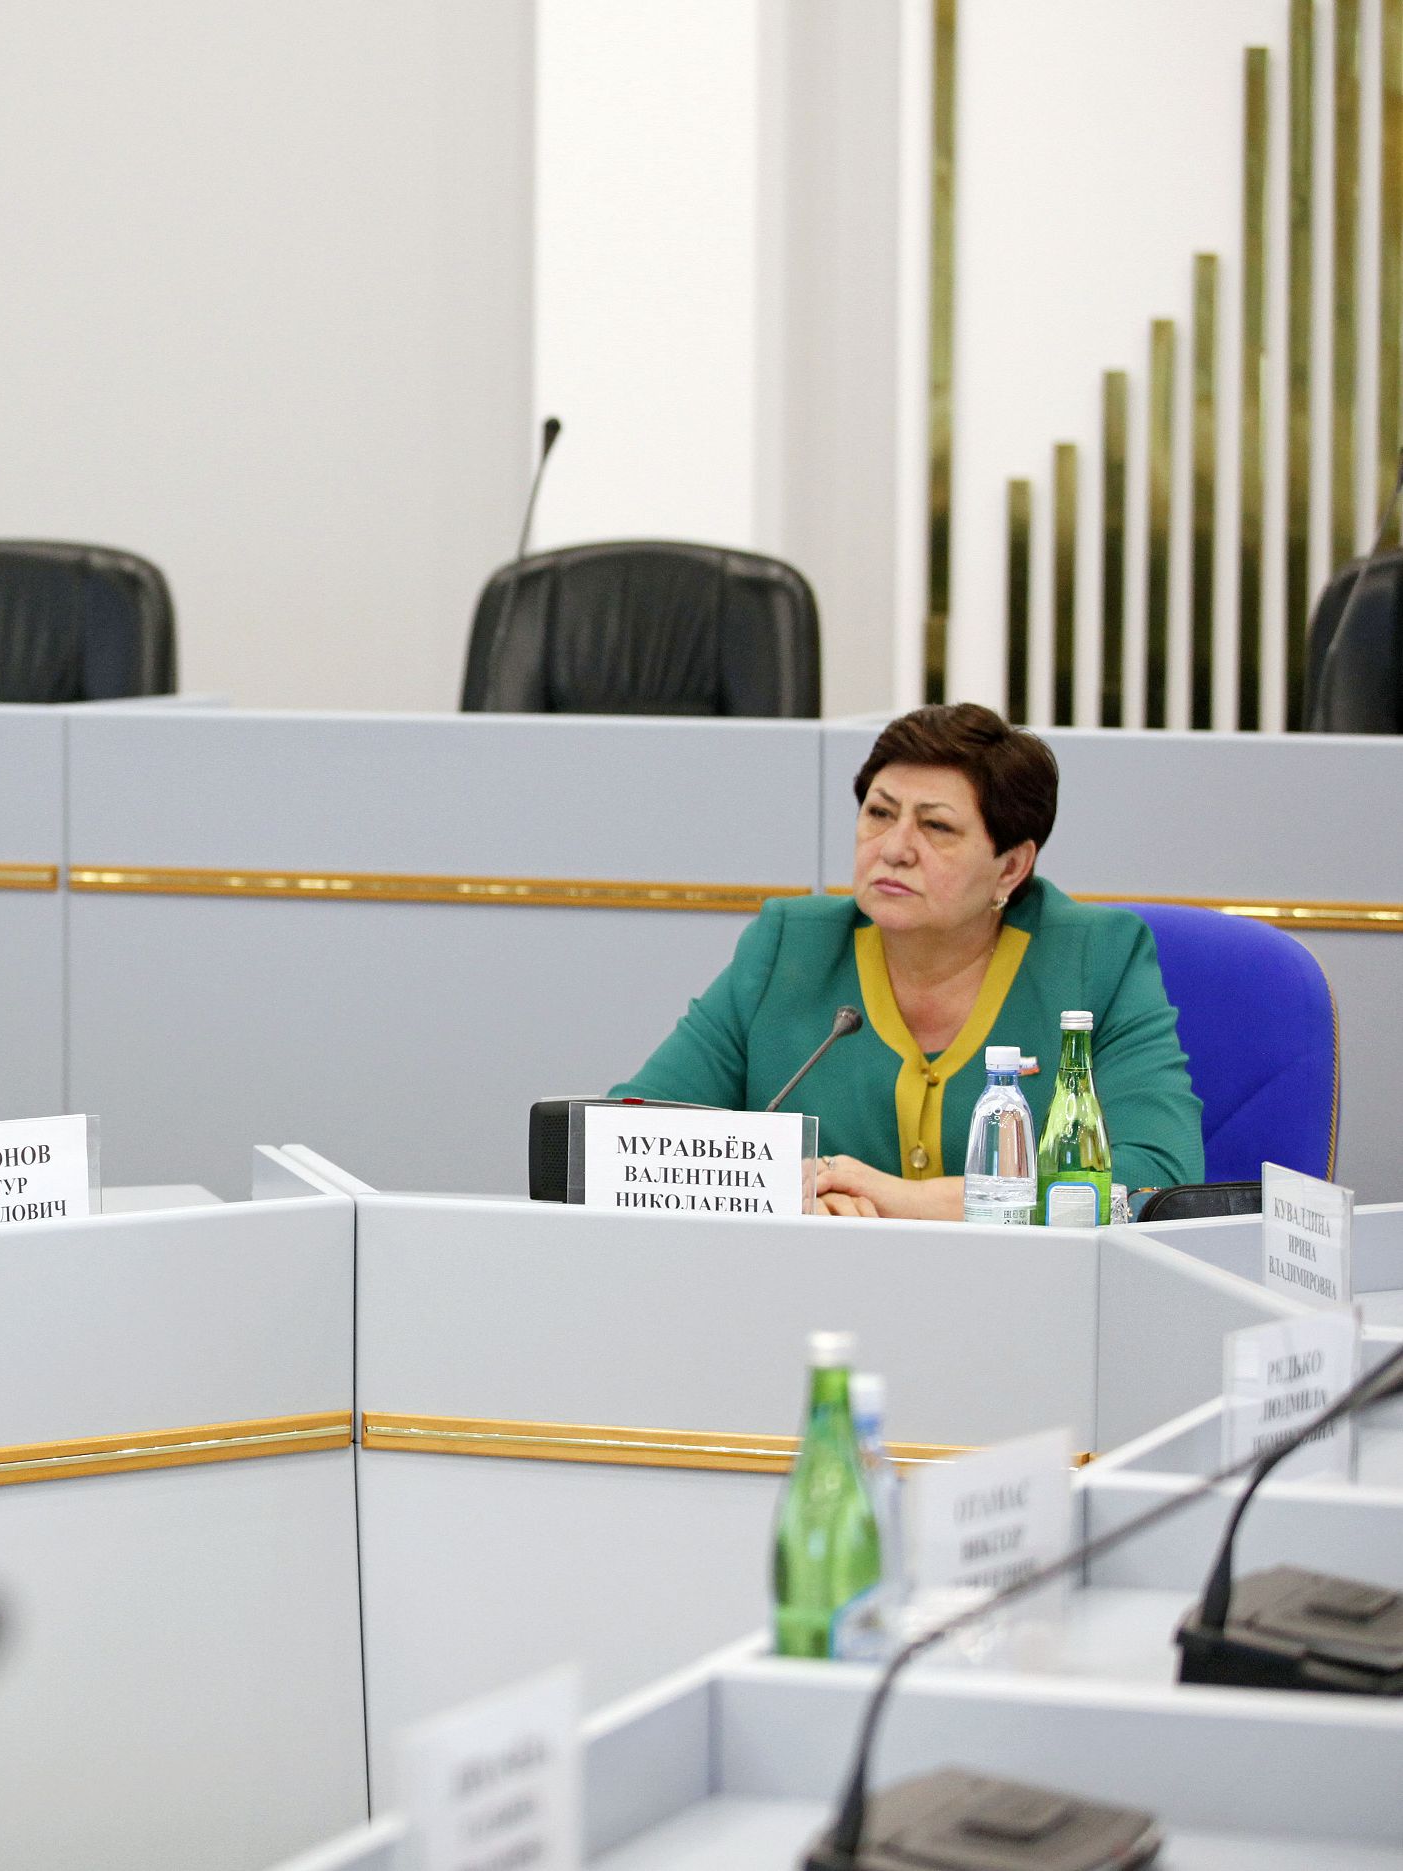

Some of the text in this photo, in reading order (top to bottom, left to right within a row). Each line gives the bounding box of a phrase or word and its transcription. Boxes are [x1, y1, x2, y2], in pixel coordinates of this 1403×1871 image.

[616, 1135, 774, 1161] МУРАВЬЁВА
[624, 1165, 766, 1188] ВАЛЕНТИНА
[615, 1191, 774, 1214] НИКОЛАЕВНА
[1274, 1197, 1330, 1238] КУВАЛДИНА
[1288, 1234, 1317, 1262] ИРИНА
[1269, 1255, 1337, 1300] ВЛАДИМИРОВНА
